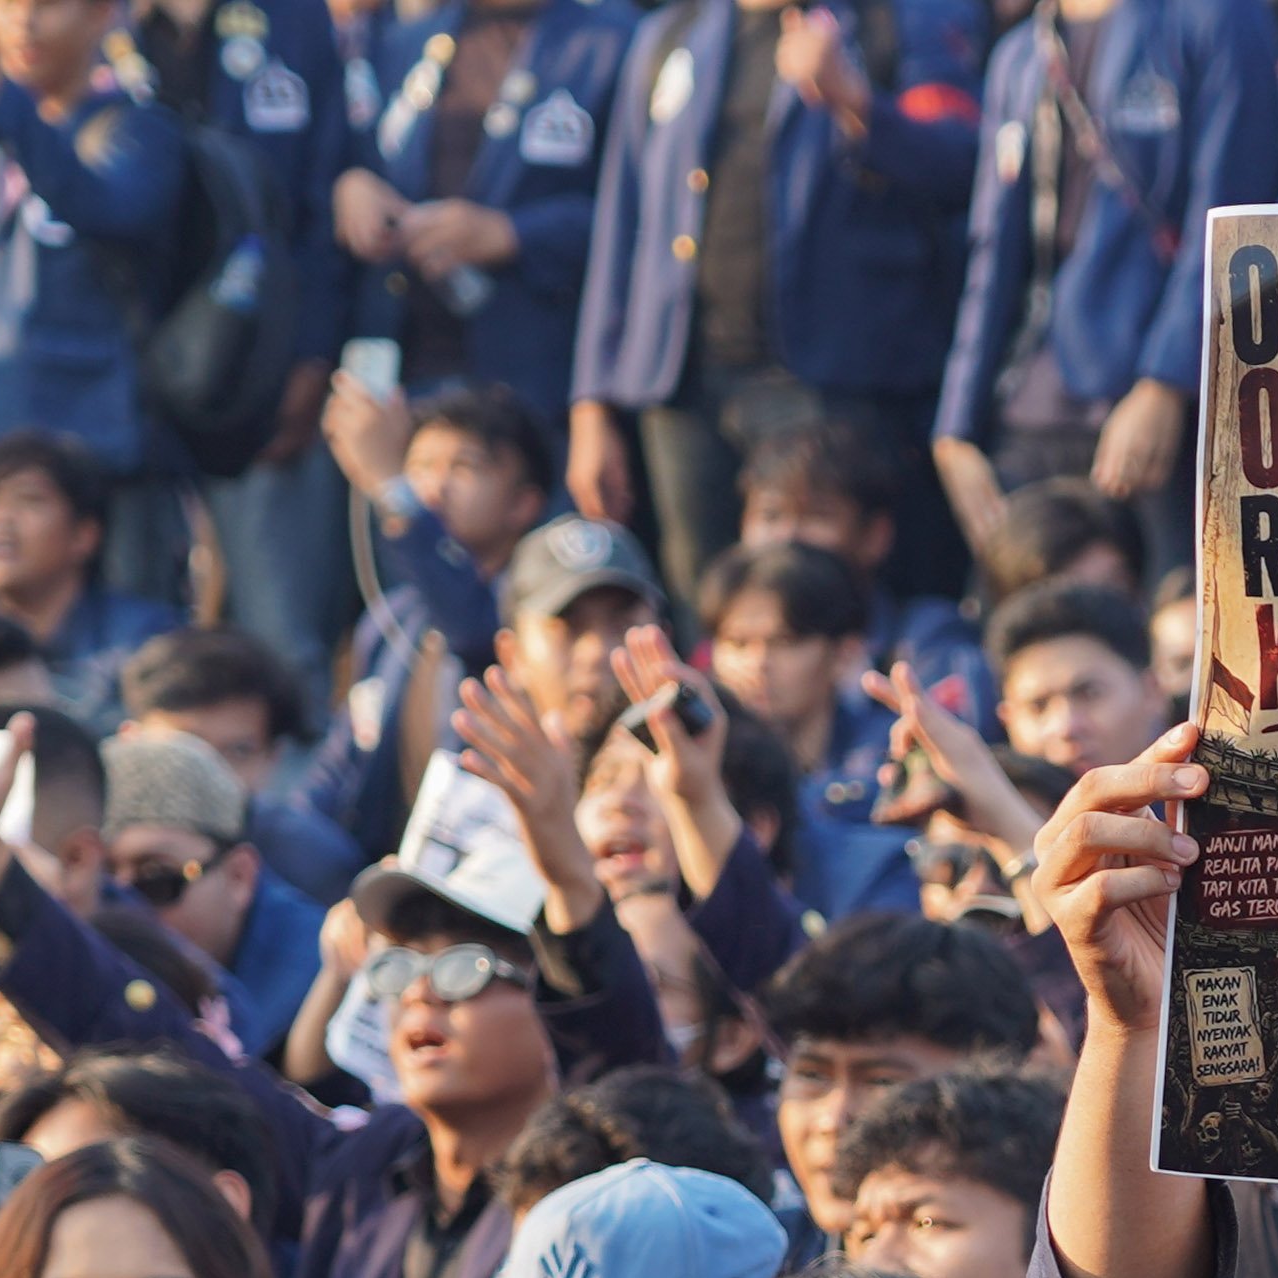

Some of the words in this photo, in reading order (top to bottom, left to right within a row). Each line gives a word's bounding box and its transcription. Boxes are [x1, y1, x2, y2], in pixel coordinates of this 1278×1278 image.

[1205, 836, 1246, 854] JANJI
[1203, 857, 1262, 876] REALITA
[1201, 880, 1232, 898] TAPI
[1237, 878, 1268, 896] KITA
[1209, 900, 1242, 918] GAS
[1195, 976, 1241, 993] MAKAN
[1202, 993, 1238, 1008] ENAK
[1203, 1010, 1241, 1026] TIDUR
[1197, 1025, 1252, 1042] NYENYAK
[1203, 1042, 1248, 1060] RAKYAT
[1196, 1057, 1261, 1077] SENGSARA!
